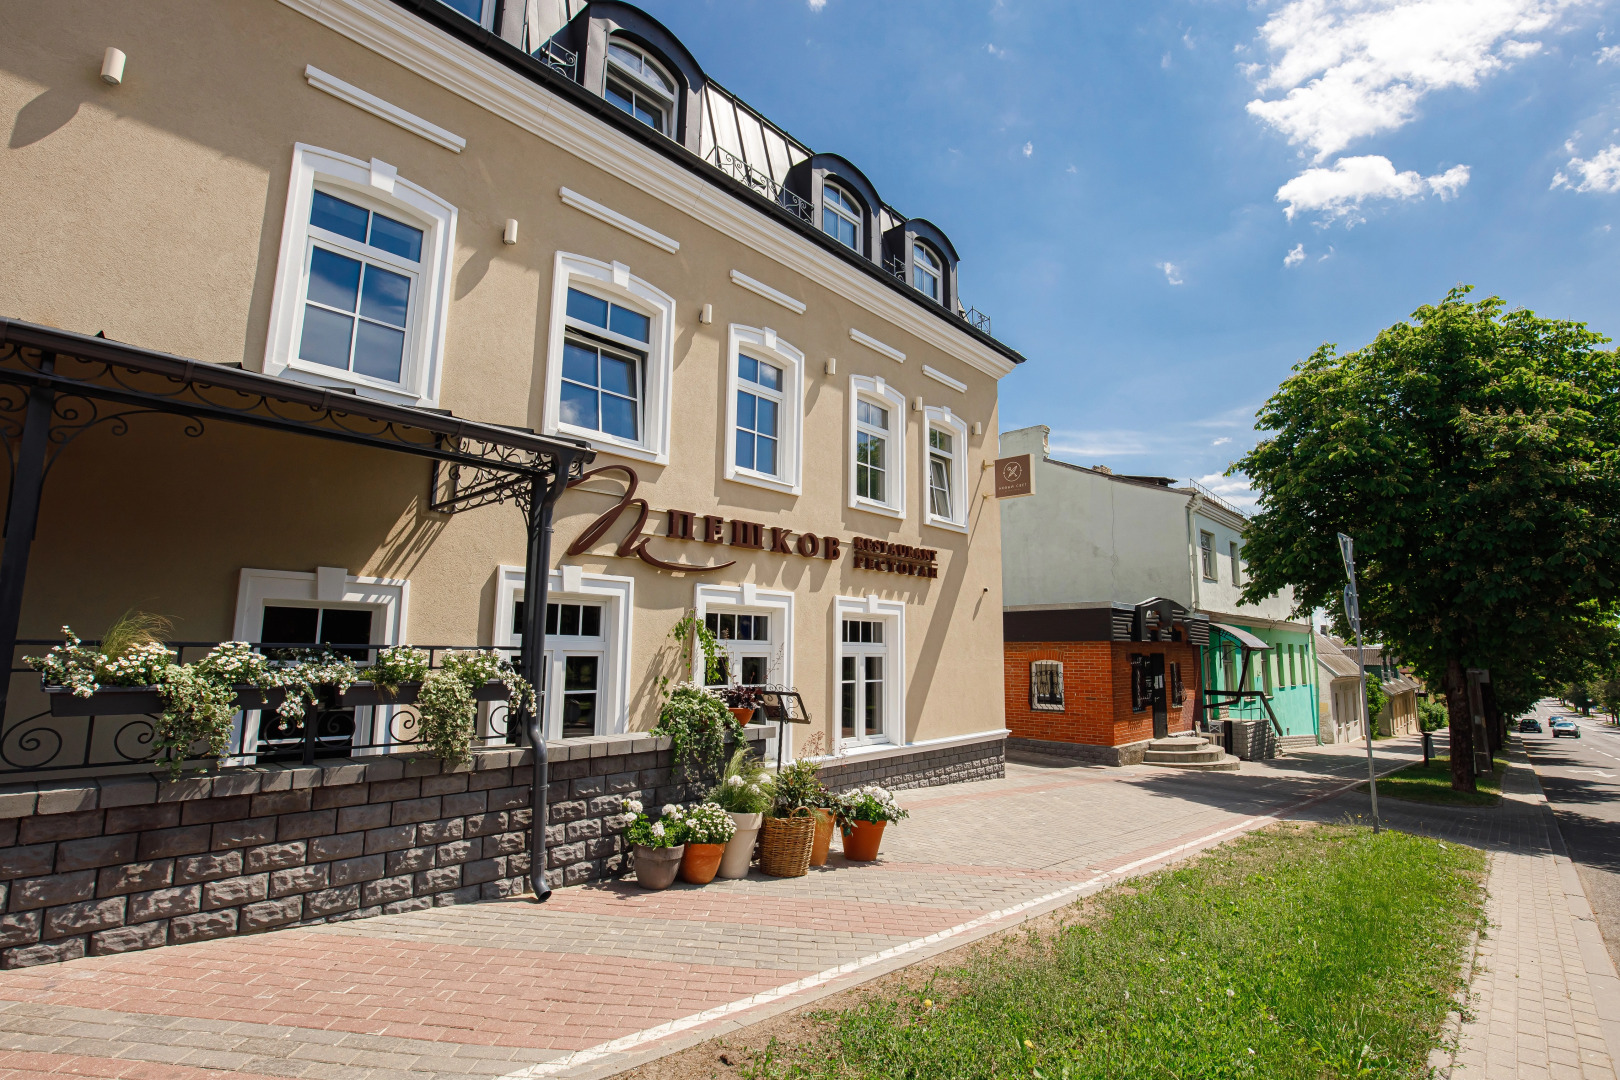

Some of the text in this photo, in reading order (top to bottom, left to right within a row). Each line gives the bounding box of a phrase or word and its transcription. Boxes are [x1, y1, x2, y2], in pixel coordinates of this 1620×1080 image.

[666, 508, 841, 561] ПЕШКОВ
[853, 536, 938, 561] RESTAURANT
[853, 556, 938, 579] РЕСТОРАН
